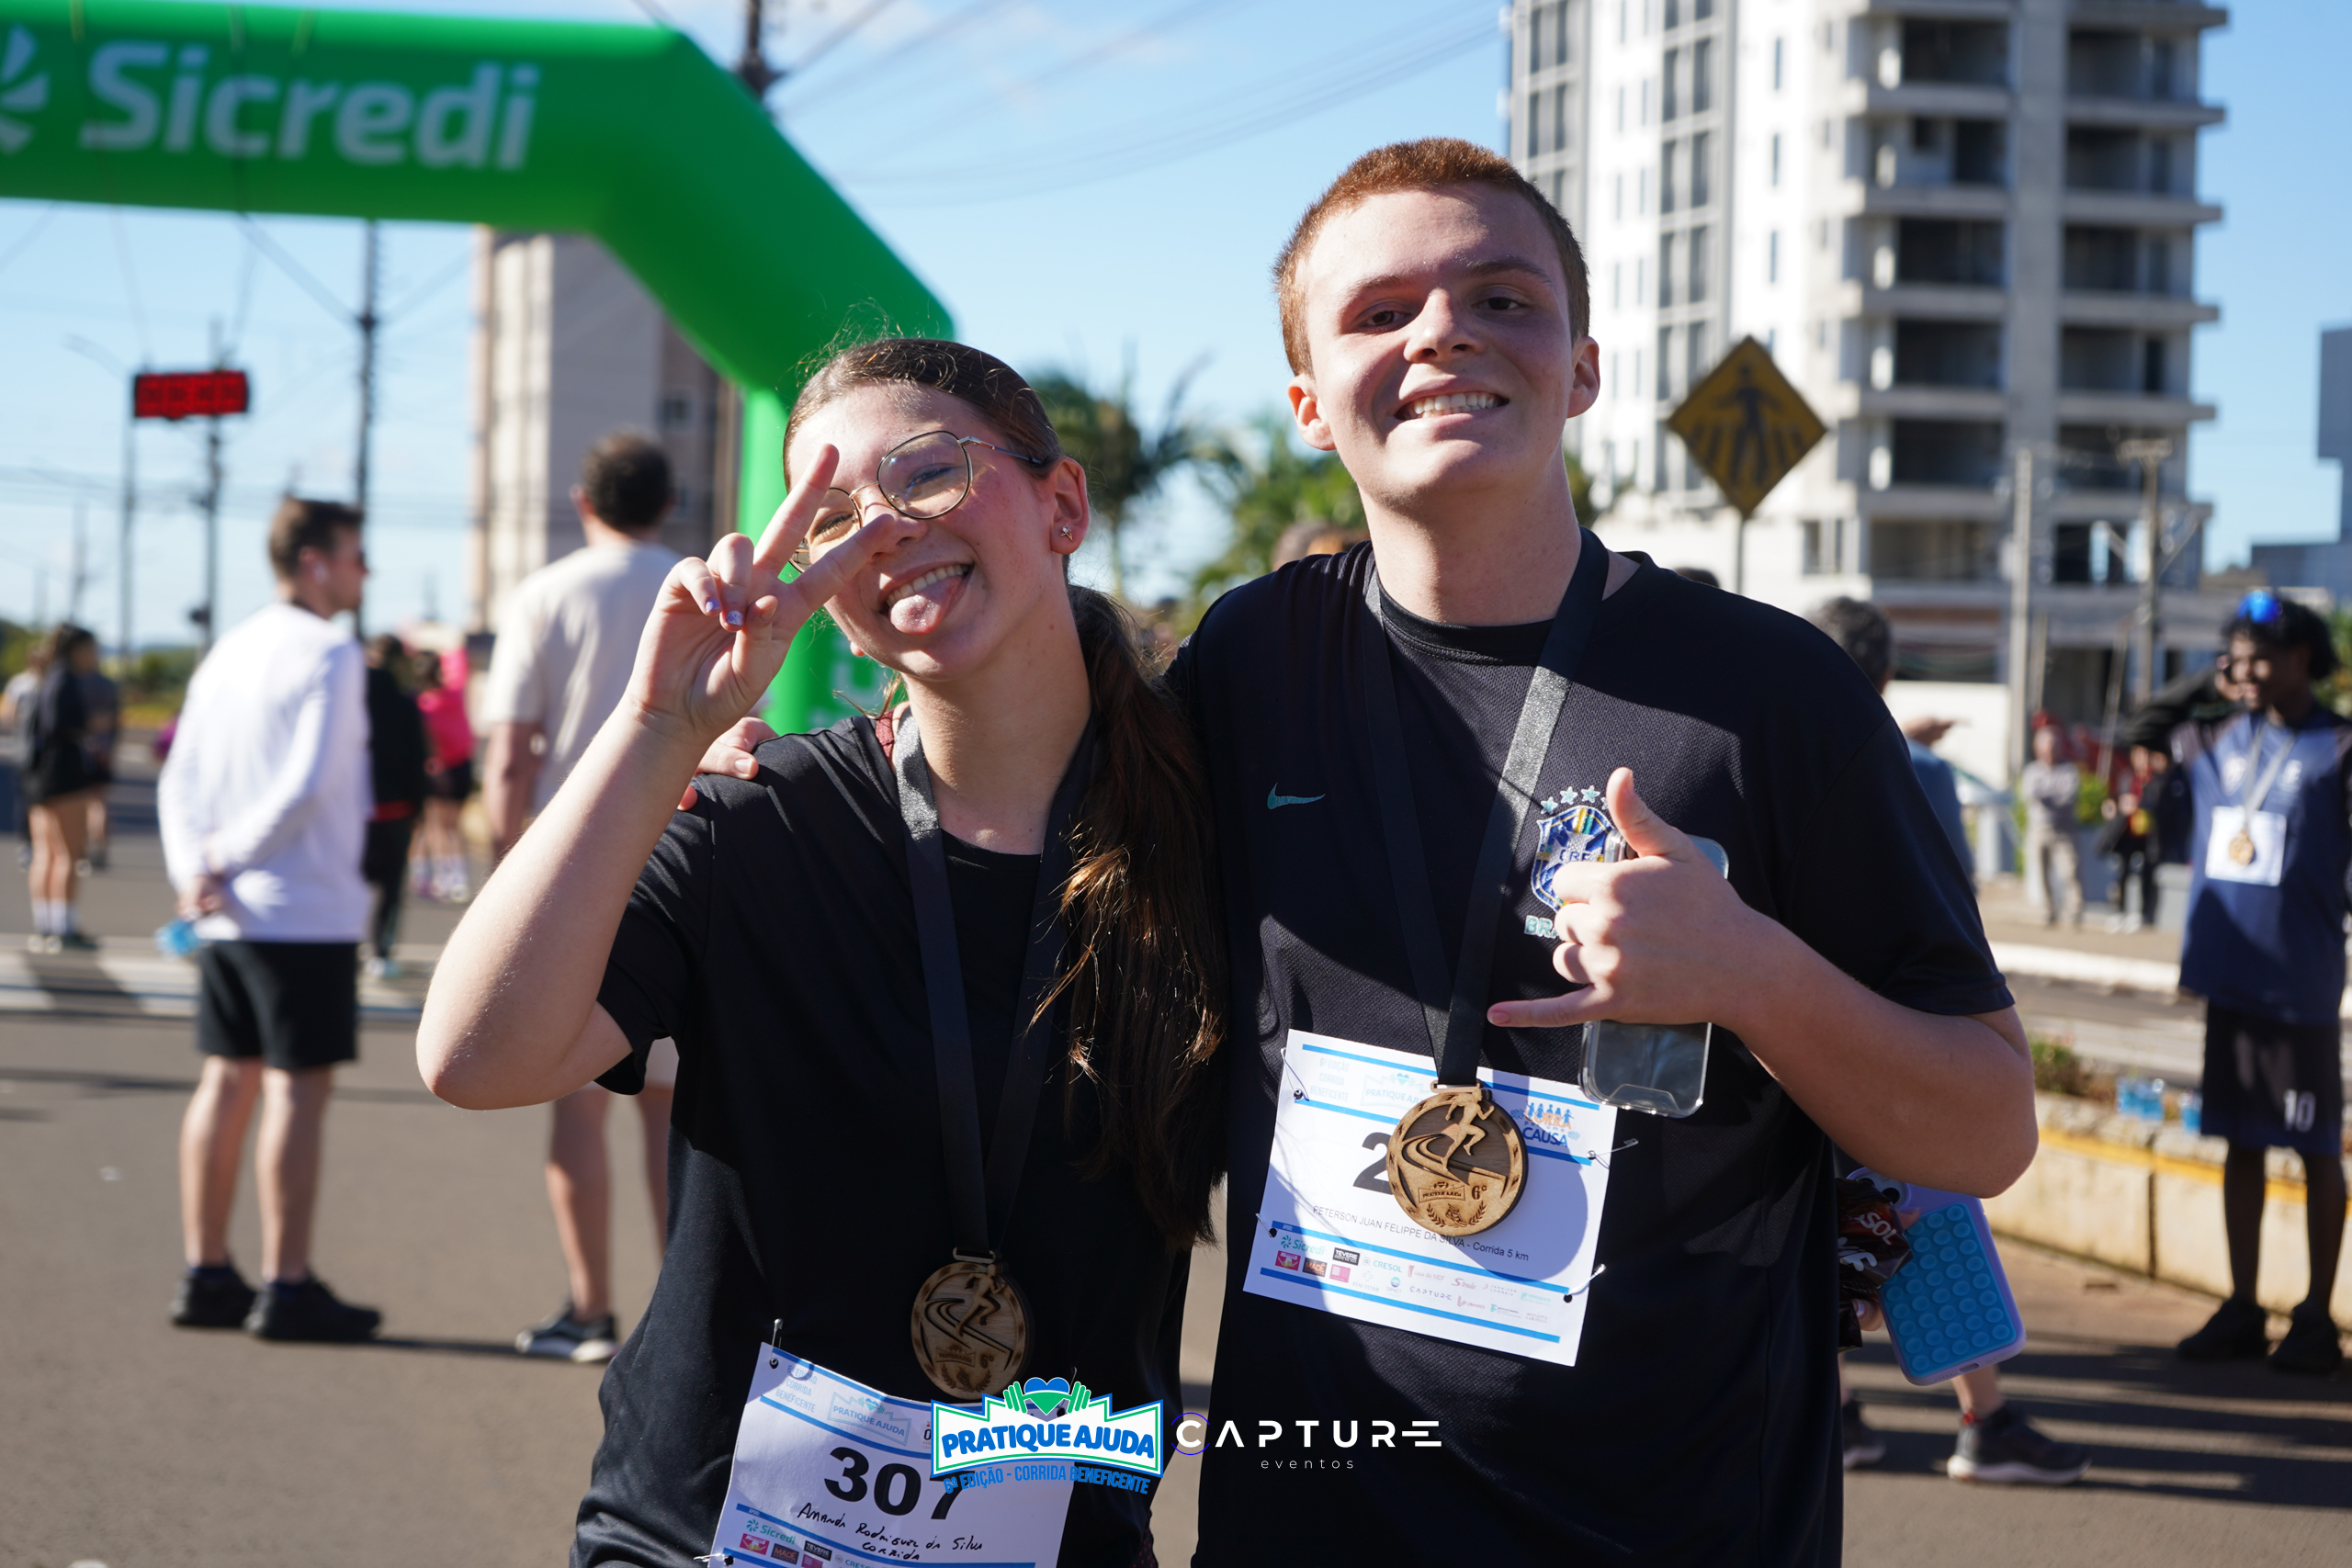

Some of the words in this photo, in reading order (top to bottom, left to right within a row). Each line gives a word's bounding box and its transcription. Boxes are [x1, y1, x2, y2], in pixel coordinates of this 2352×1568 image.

[78, 39, 542, 171] Sicredi
[1328, 1058, 1350, 1073] EDIÇÃO
[1319, 1072, 1345, 1087] CORRIDA
[1309, 1085, 1350, 1102] BENEFICENTE
[1365, 1089, 1406, 1101] PRATIQUE
[2284, 1089, 2316, 1133] 10
[1522, 1127, 1568, 1148] CAUSA
[1313, 1205, 1358, 1224] PETERSON
[1359, 1216, 1383, 1229] JUAN
[1384, 1222, 1422, 1238] FELIPPE
[1424, 1231, 1437, 1241] DA
[1439, 1234, 1465, 1247] SILVA
[1473, 1241, 1505, 1257] Corrida
[1507, 1248, 1513, 1258] 5
[1515, 1250, 1529, 1261] km
[1293, 1240, 1325, 1256] Sicredi
[1373, 1260, 1402, 1273] CRESOL
[1409, 1286, 1452, 1301] CAPTURE
[796, 1366, 818, 1385] EDIÇÃO
[786, 1378, 812, 1397] CORRIDA
[775, 1386, 817, 1415] BENEFICENTE
[833, 1405, 876, 1426] PRATIQUE
[876, 1419, 906, 1437] AJUDA
[824, 1447, 976, 1520] 307
[760, 1525, 796, 1545] Sicredi
[952, 1535, 983, 1551] Silva
